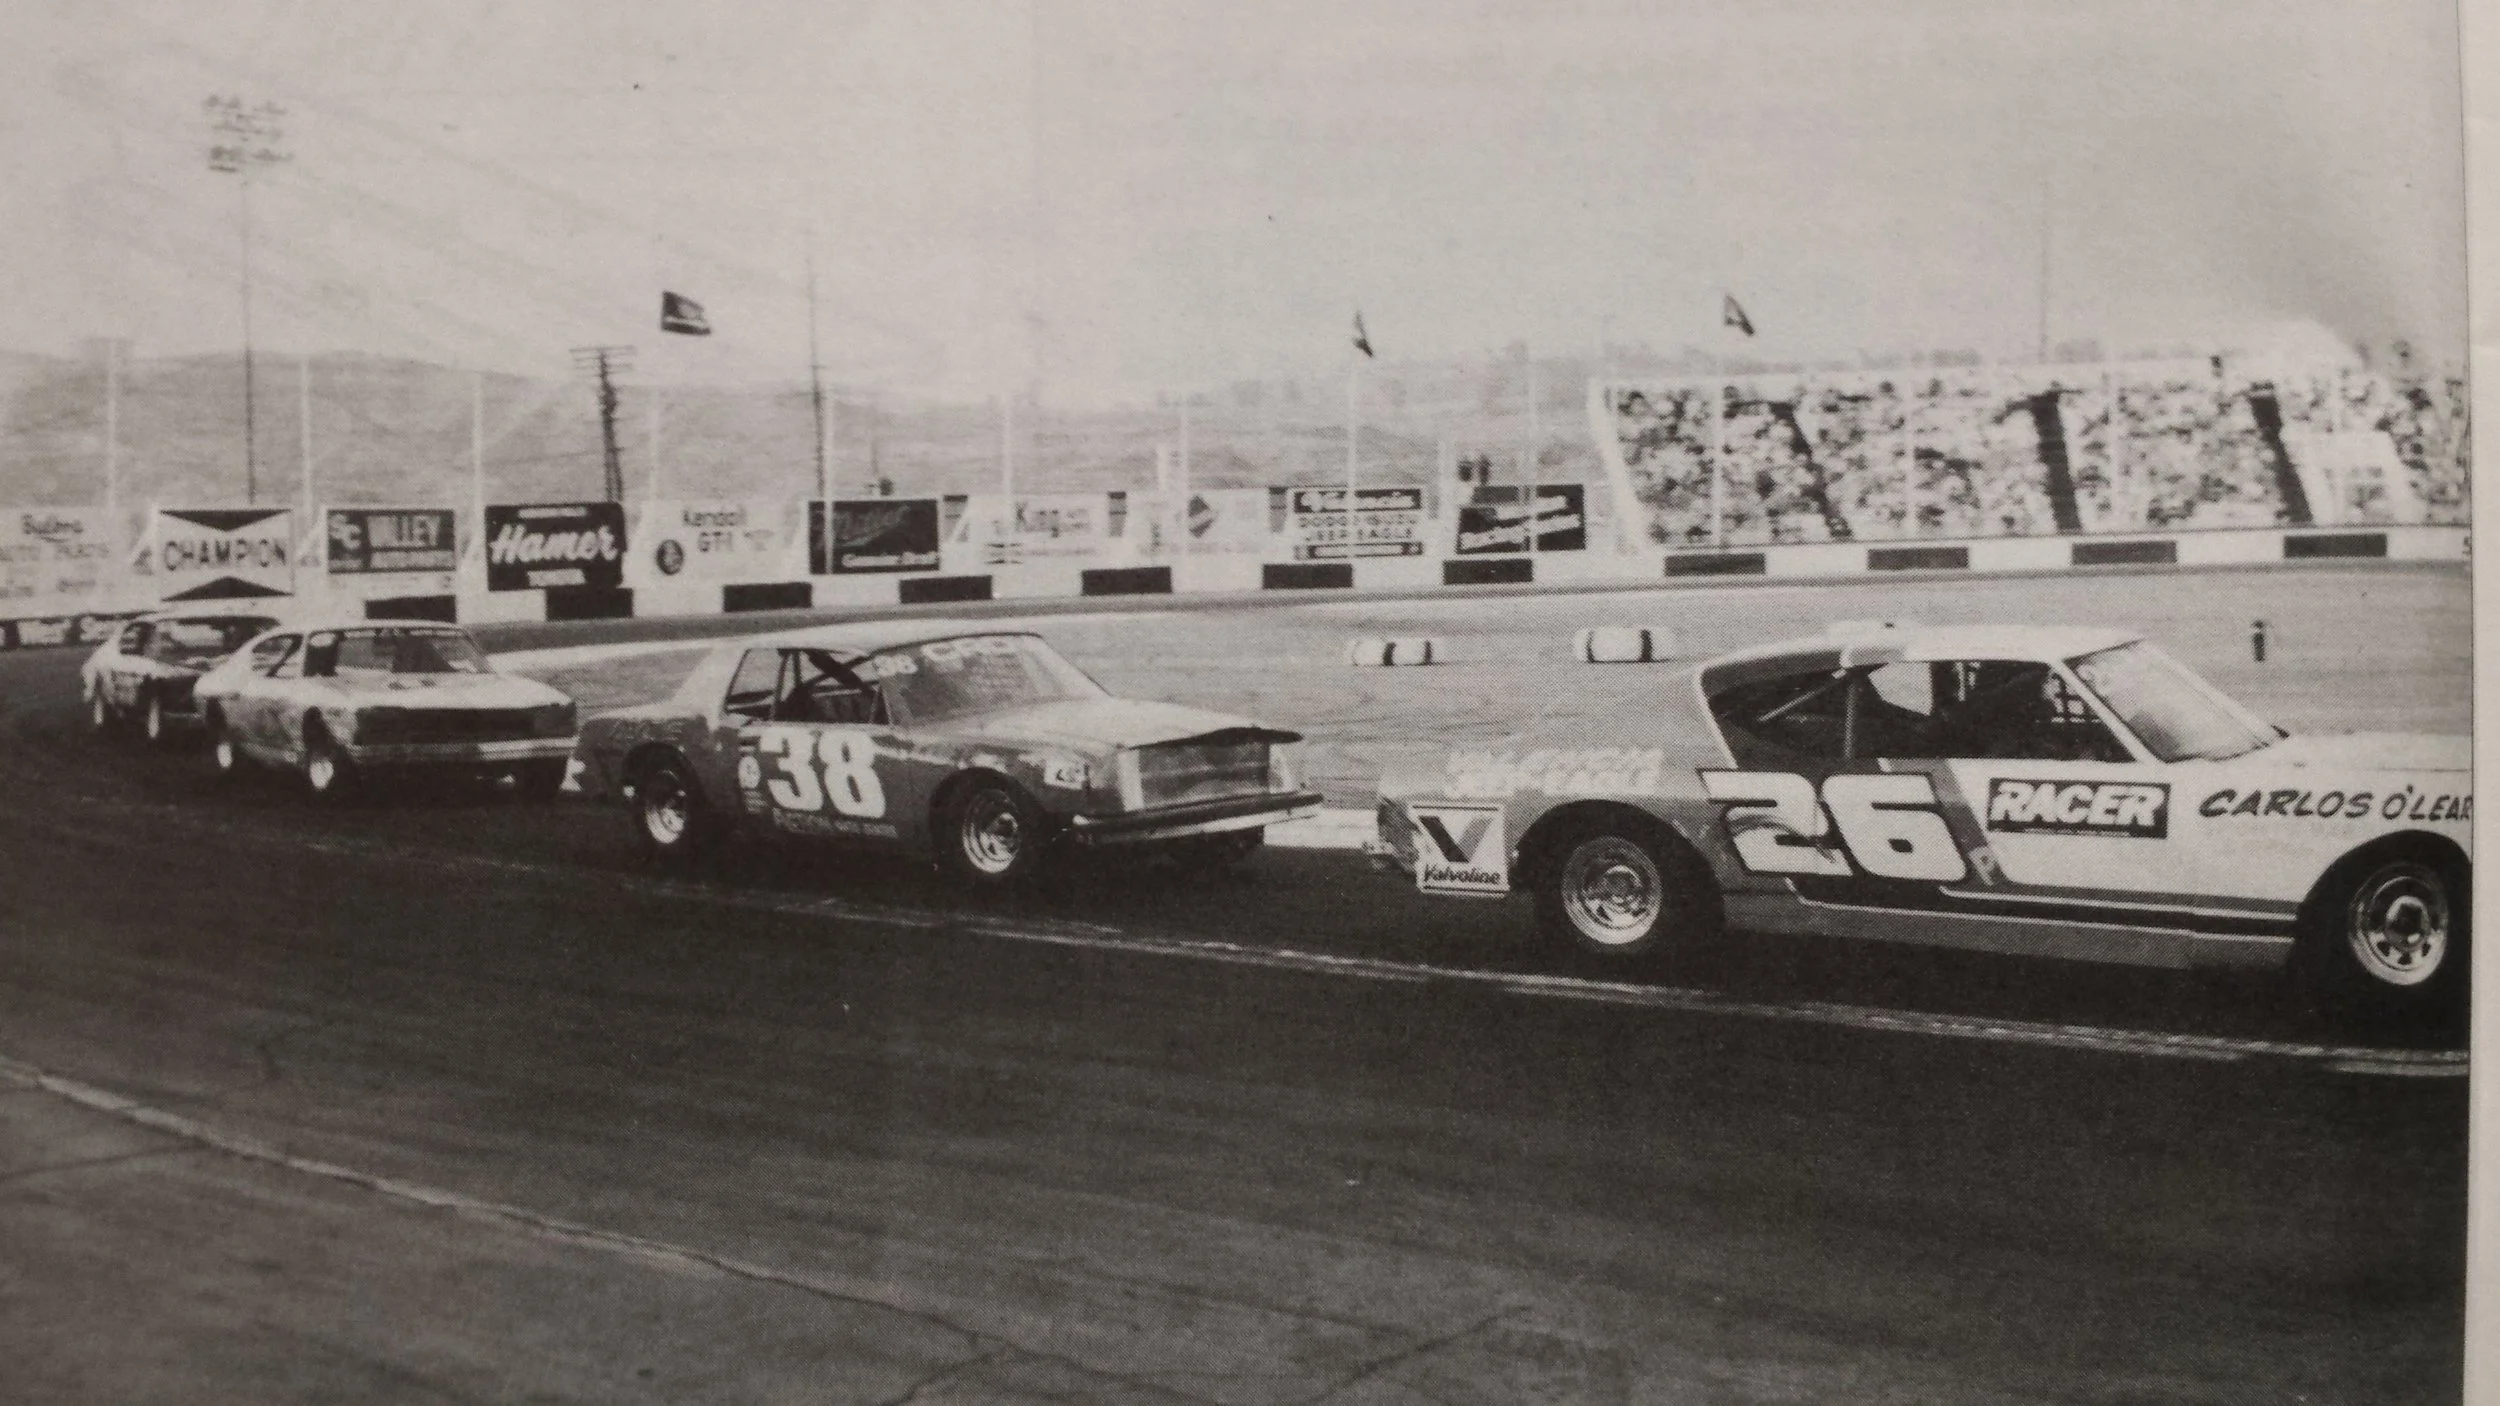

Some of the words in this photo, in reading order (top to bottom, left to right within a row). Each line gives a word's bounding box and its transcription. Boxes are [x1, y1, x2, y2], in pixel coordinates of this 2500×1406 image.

[163, 538, 287, 571] CHAMPION
[759, 727, 887, 819] 38
[1989, 781, 2164, 827] RACER
[2199, 788, 2374, 818] CARLOS
[1702, 771, 1966, 881] 26
[1424, 863, 1501, 885] Valvoline
